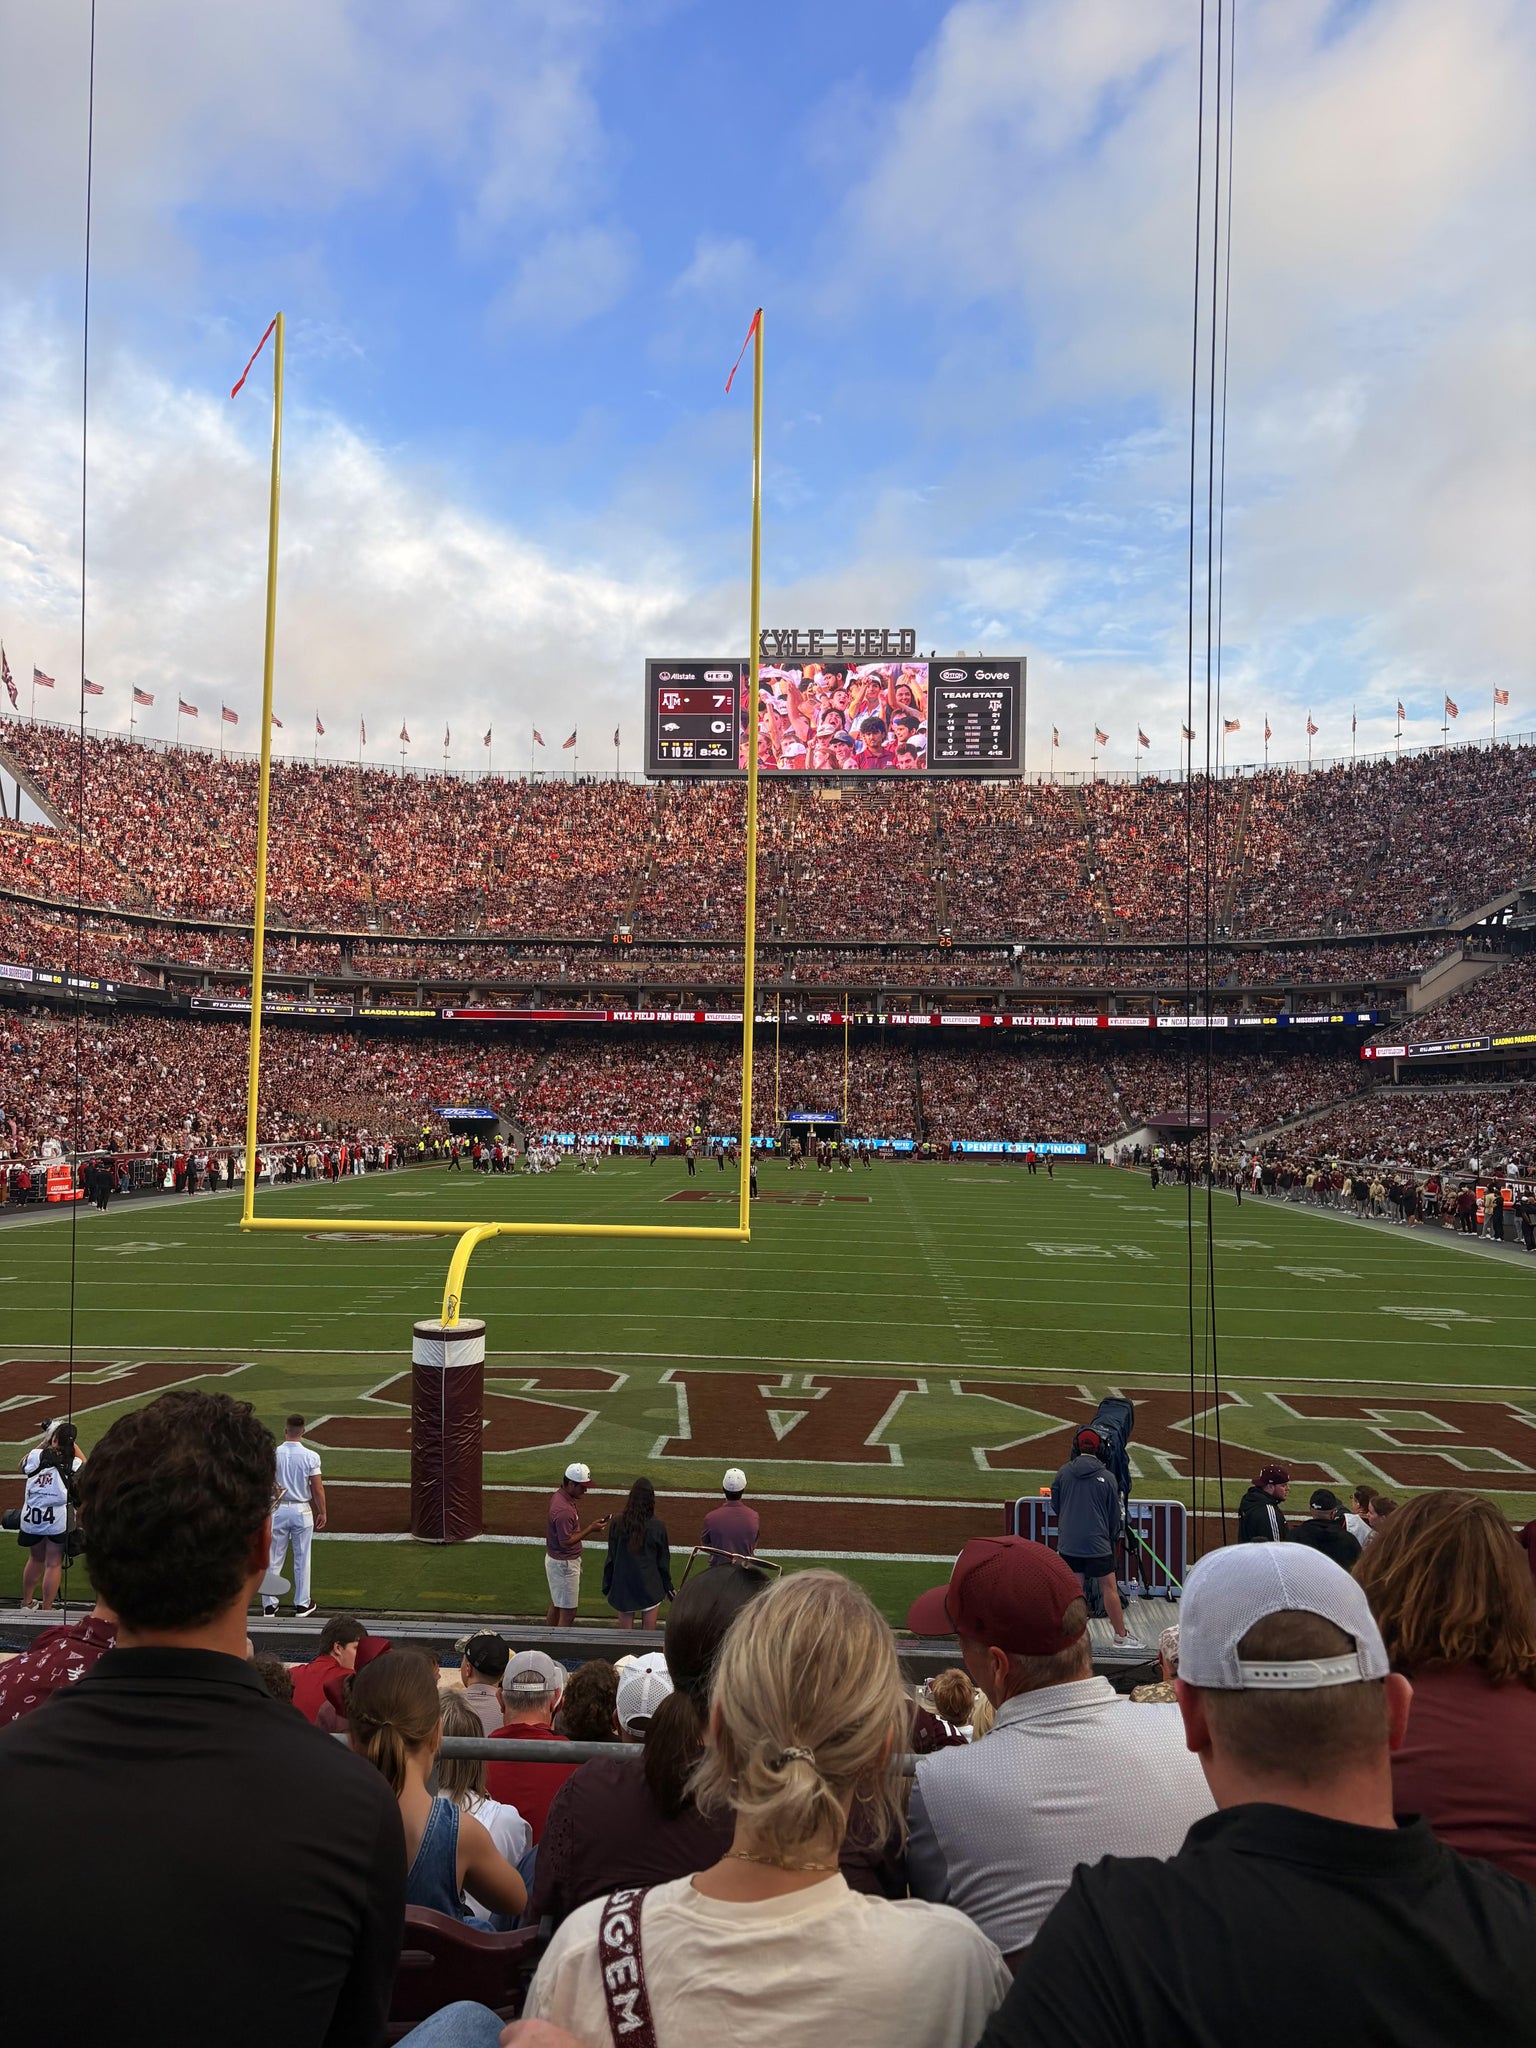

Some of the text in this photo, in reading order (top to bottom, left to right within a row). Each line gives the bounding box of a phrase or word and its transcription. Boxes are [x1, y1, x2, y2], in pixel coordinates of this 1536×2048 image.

[835, 629, 916, 657] FIELD
[974, 670, 1010, 680] Govee
[712, 695, 726, 708] 7
[711, 721, 725, 733] 0
[663, 747, 693, 757] 1 10 22
[940, 938, 951, 946] 25
[614, 1012, 695, 1021] KYLE FIELD FAN GUIDE
[892, 1015, 931, 1024] FAN GUIDE
[1012, 1017, 1098, 1026] KYLE FIELD FAN GUIDE
[966, 1143, 1006, 1152] PENFE
[24, 1506, 55, 1524] 204
